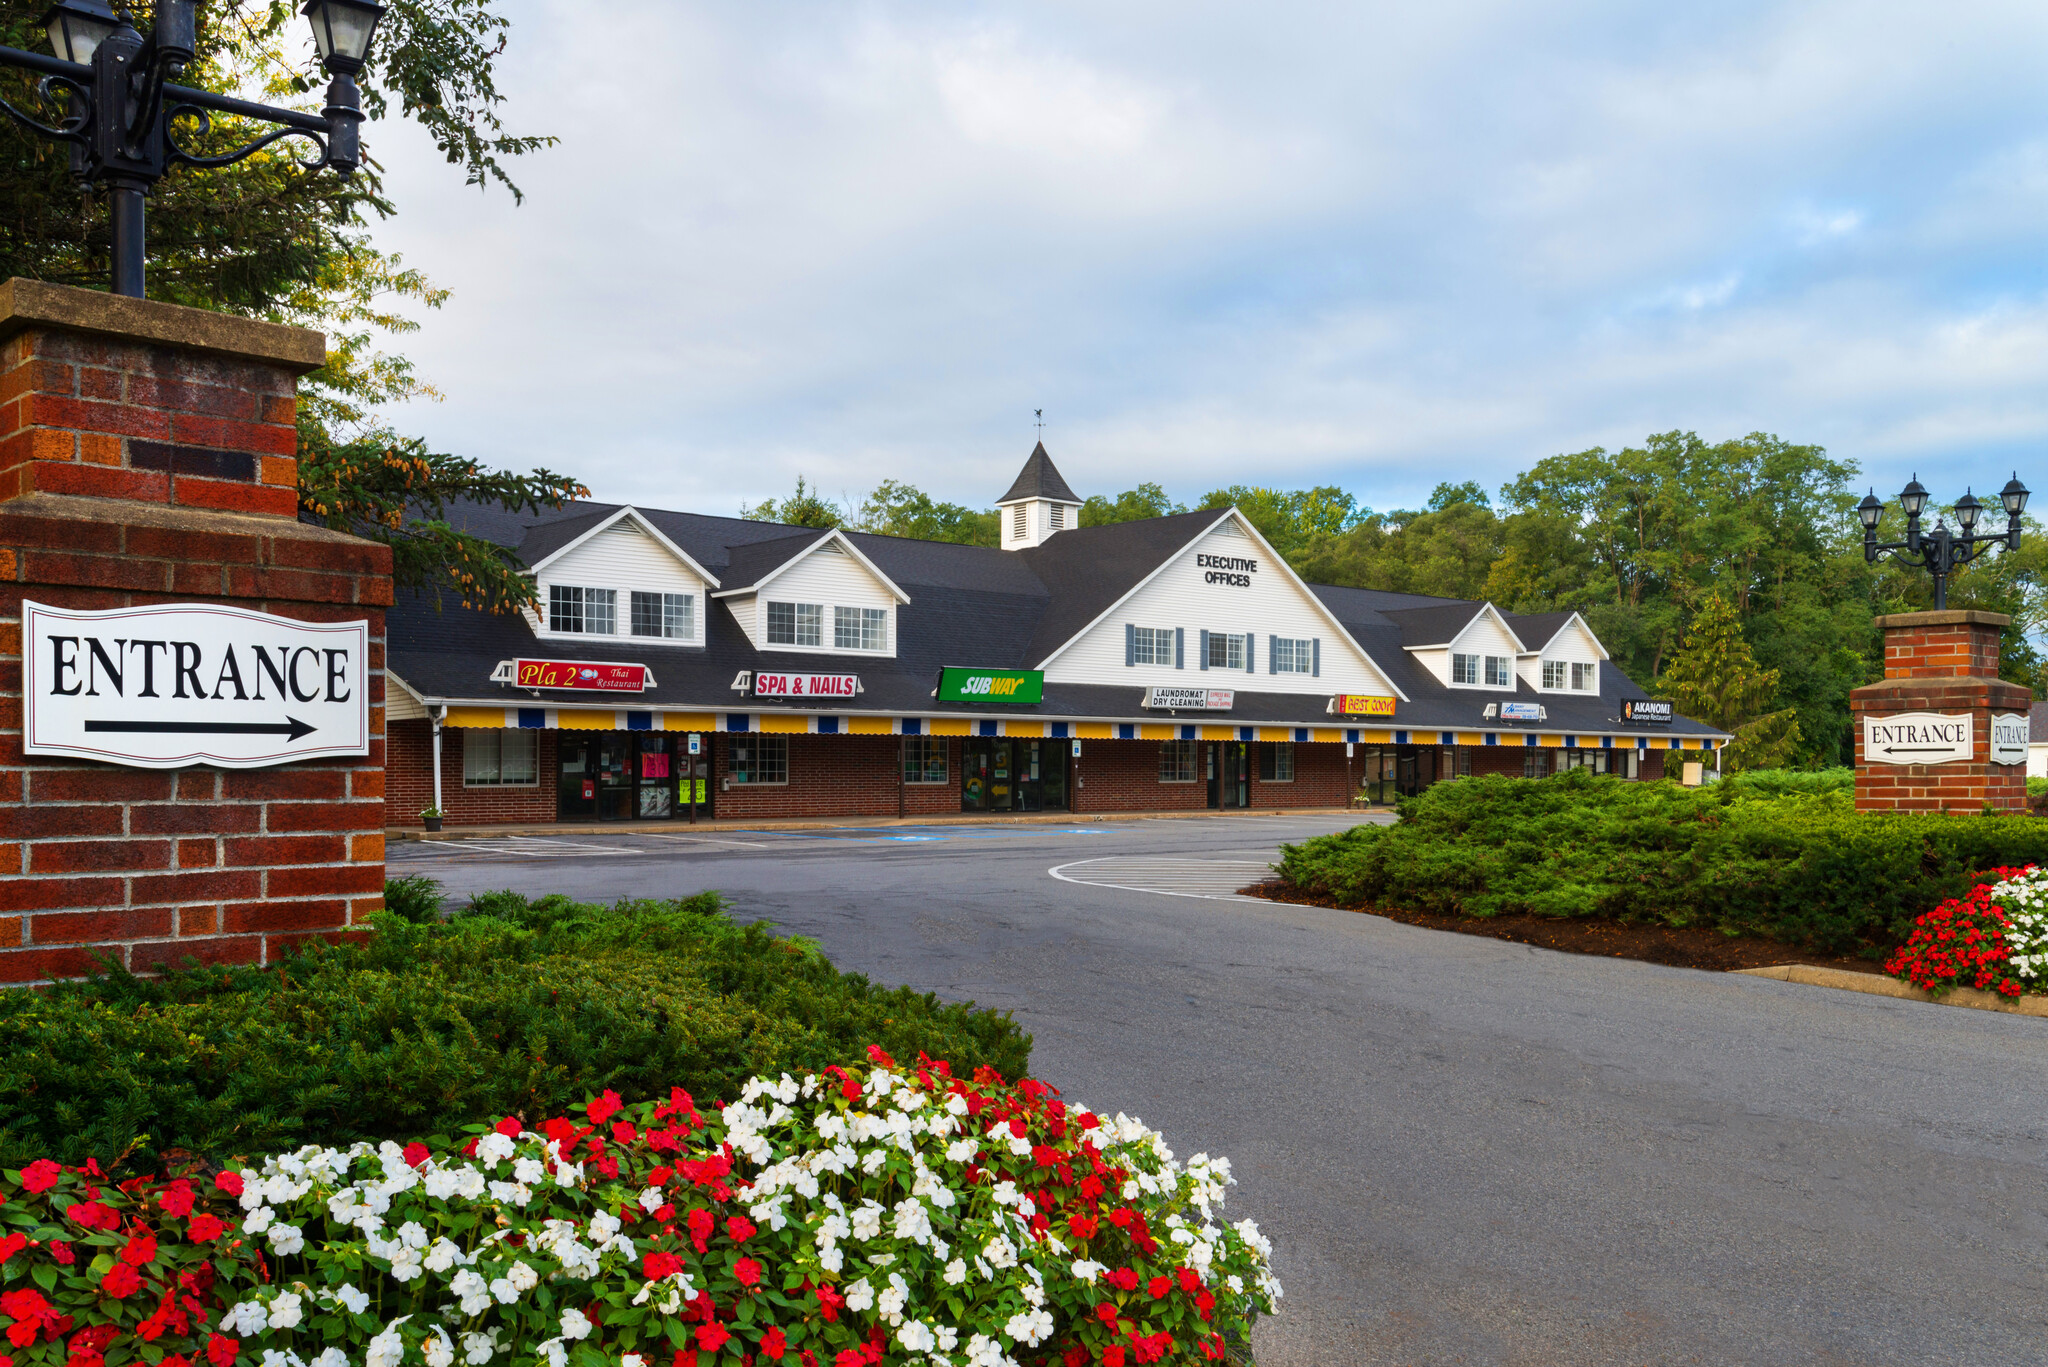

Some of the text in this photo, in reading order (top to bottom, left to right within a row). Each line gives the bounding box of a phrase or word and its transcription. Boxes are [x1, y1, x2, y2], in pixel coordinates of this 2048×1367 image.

[1197, 553, 1257, 573] EXECUTIVE
[1205, 571, 1250, 587] OFFICES
[47, 635, 351, 703] ENTRANCE
[520, 662, 577, 686] Pla 2
[611, 667, 630, 678] Thai
[596, 678, 641, 689] Restaurant
[757, 674, 853, 695] SPA & NAILS
[960, 676, 1024, 695] SUBWAY
[1153, 697, 1204, 707] DRY CLEANING
[1156, 689, 1203, 699] LAUNDROMAT
[1348, 698, 1370, 711] BEST
[1371, 699, 1393, 712] COOK
[1634, 701, 1670, 714] AKANOMI
[1632, 712, 1671, 721] Japanese Restaurant
[1871, 724, 1965, 744] ENTRANCE
[1995, 725, 2027, 744] ENTRANCE
